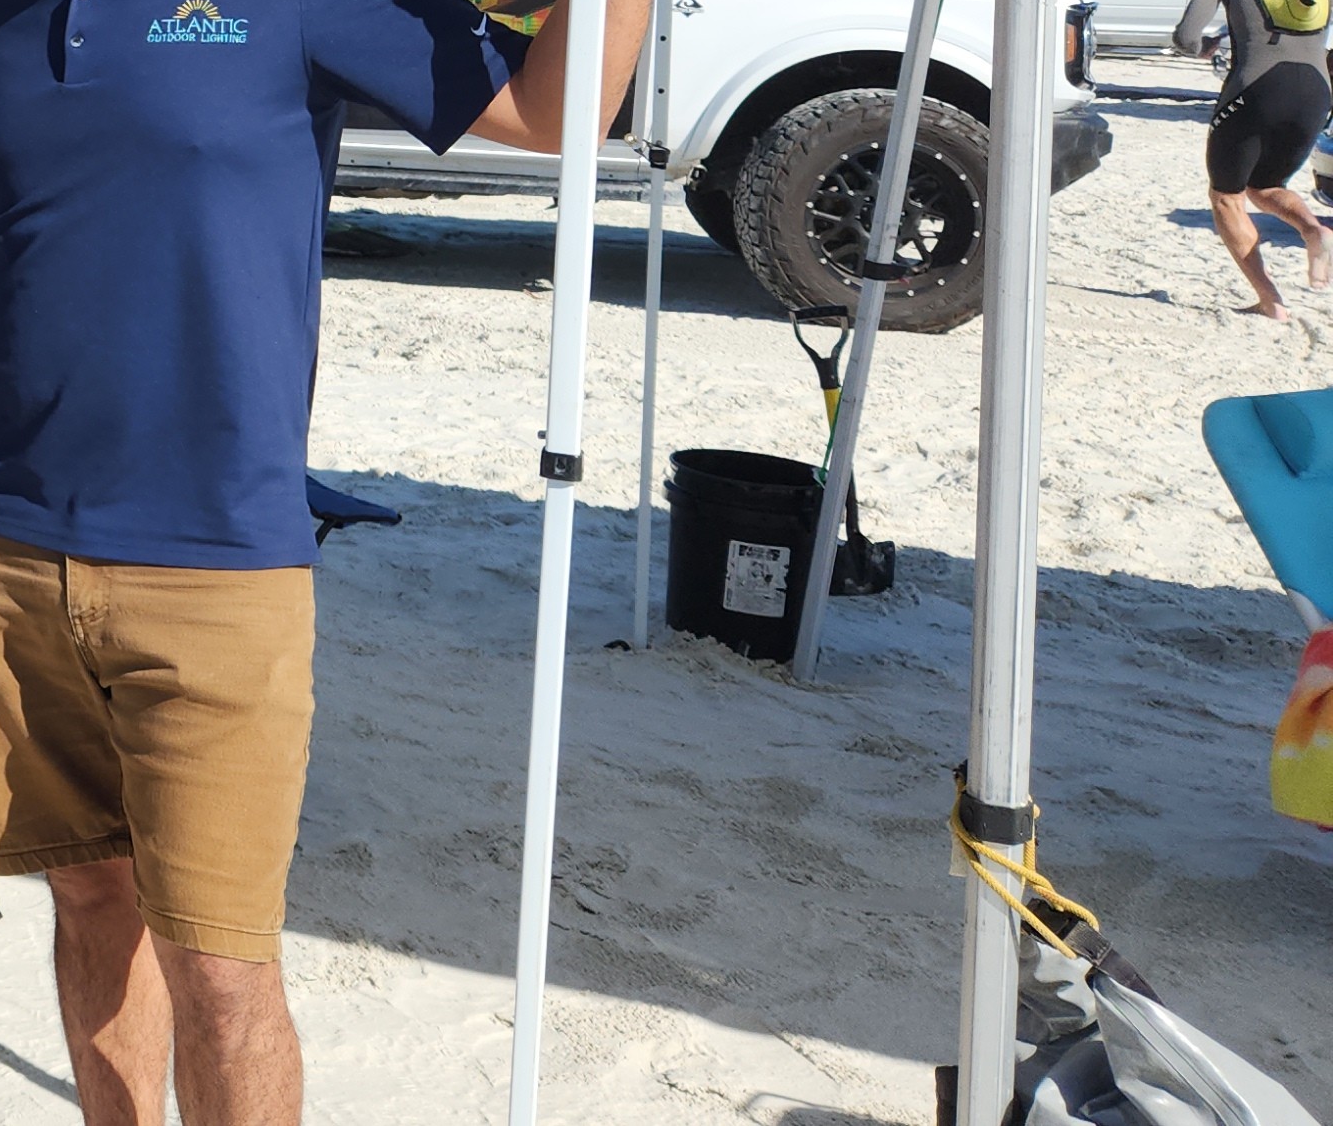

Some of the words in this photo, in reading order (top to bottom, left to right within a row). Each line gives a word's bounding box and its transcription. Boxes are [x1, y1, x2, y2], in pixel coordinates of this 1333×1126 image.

[148, 16, 249, 34] ATLANTIC
[147, 33, 196, 43] OUTDOOR
[200, 34, 247, 44] LIGHTING
